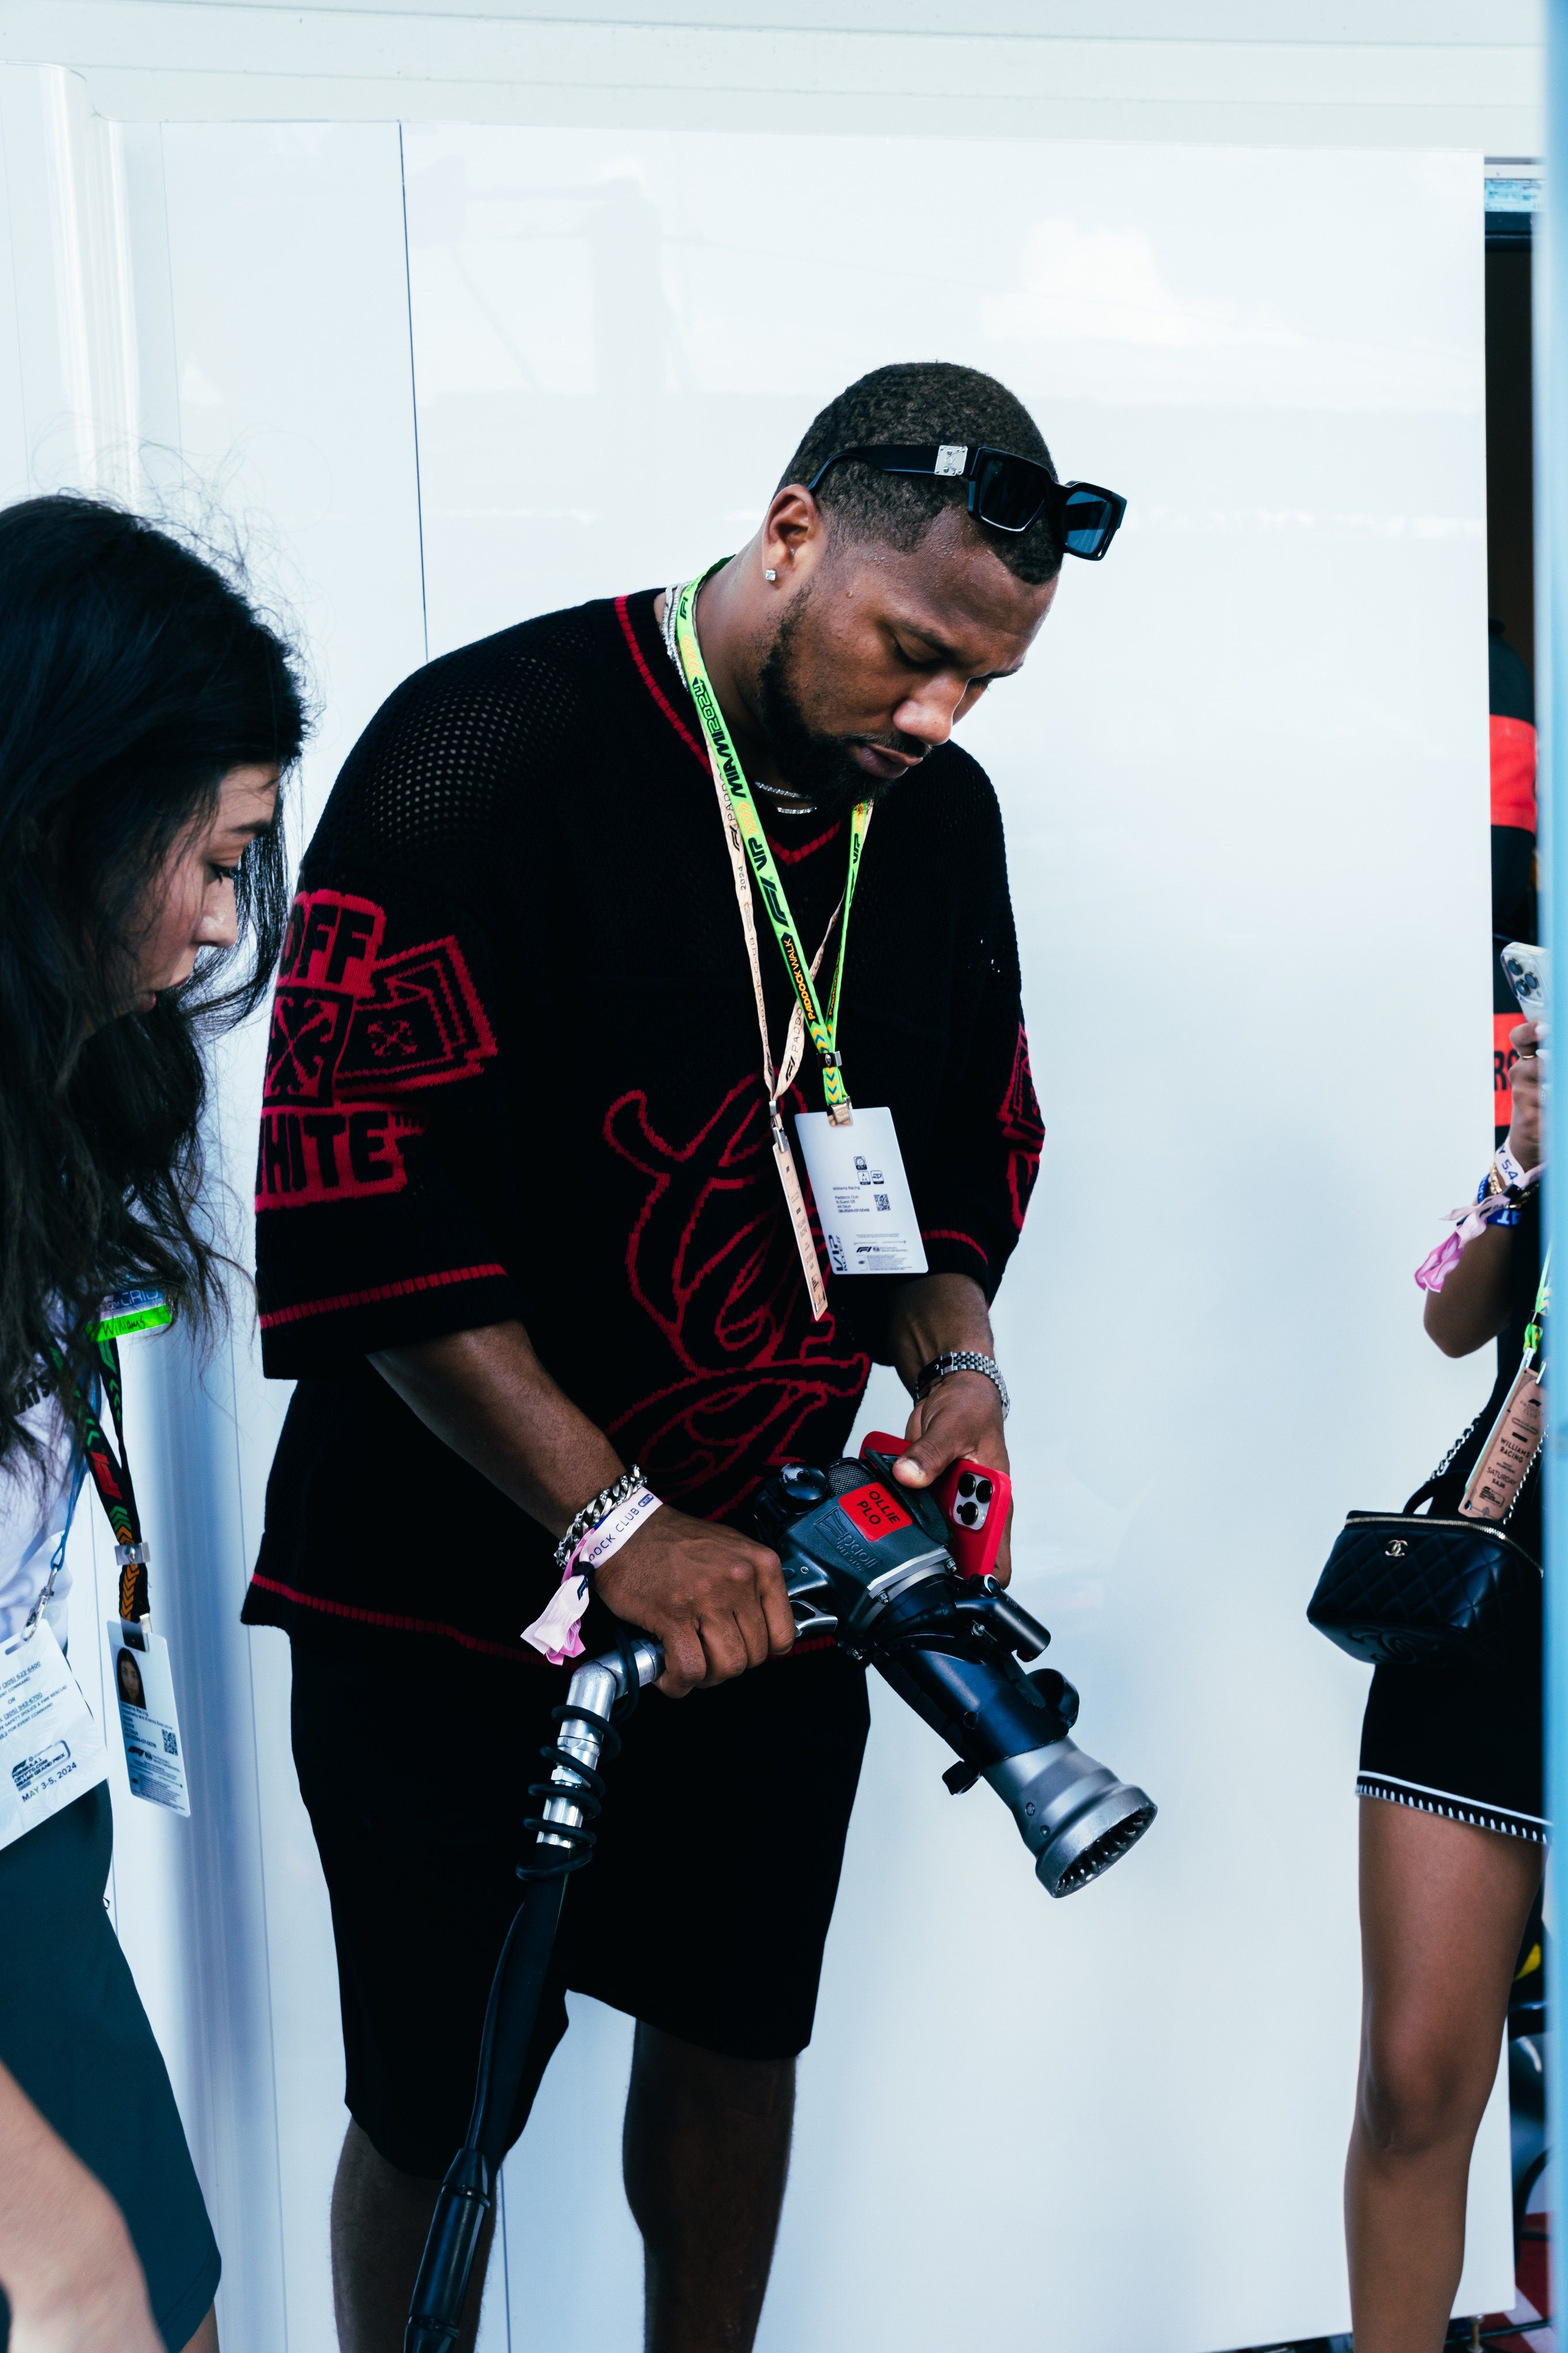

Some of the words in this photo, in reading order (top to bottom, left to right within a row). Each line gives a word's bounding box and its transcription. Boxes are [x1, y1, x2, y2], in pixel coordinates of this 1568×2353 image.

[748, 837, 768, 871] VIP
[783, 938, 800, 970] WALK
[794, 969, 816, 1021] PADDOCK
[102, 1315, 146, 1338] Williams
[1500, 1446, 1523, 1463] RACING
[616, 1507, 639, 1533] CLUB
[856, 1501, 881, 1525] PLO
[869, 1491, 901, 1524] OLLIE
[8, 1676, 30, 1693] COMMAND
[17, 1716, 30, 1727] EVENT
[31, 1702, 54, 1719] COMMAND
[34, 1761, 52, 1775] GRAND
[22, 1786, 39, 1802] MAY
[41, 1776, 57, 1790] 3-5,
[57, 1761, 77, 1779] 2024
